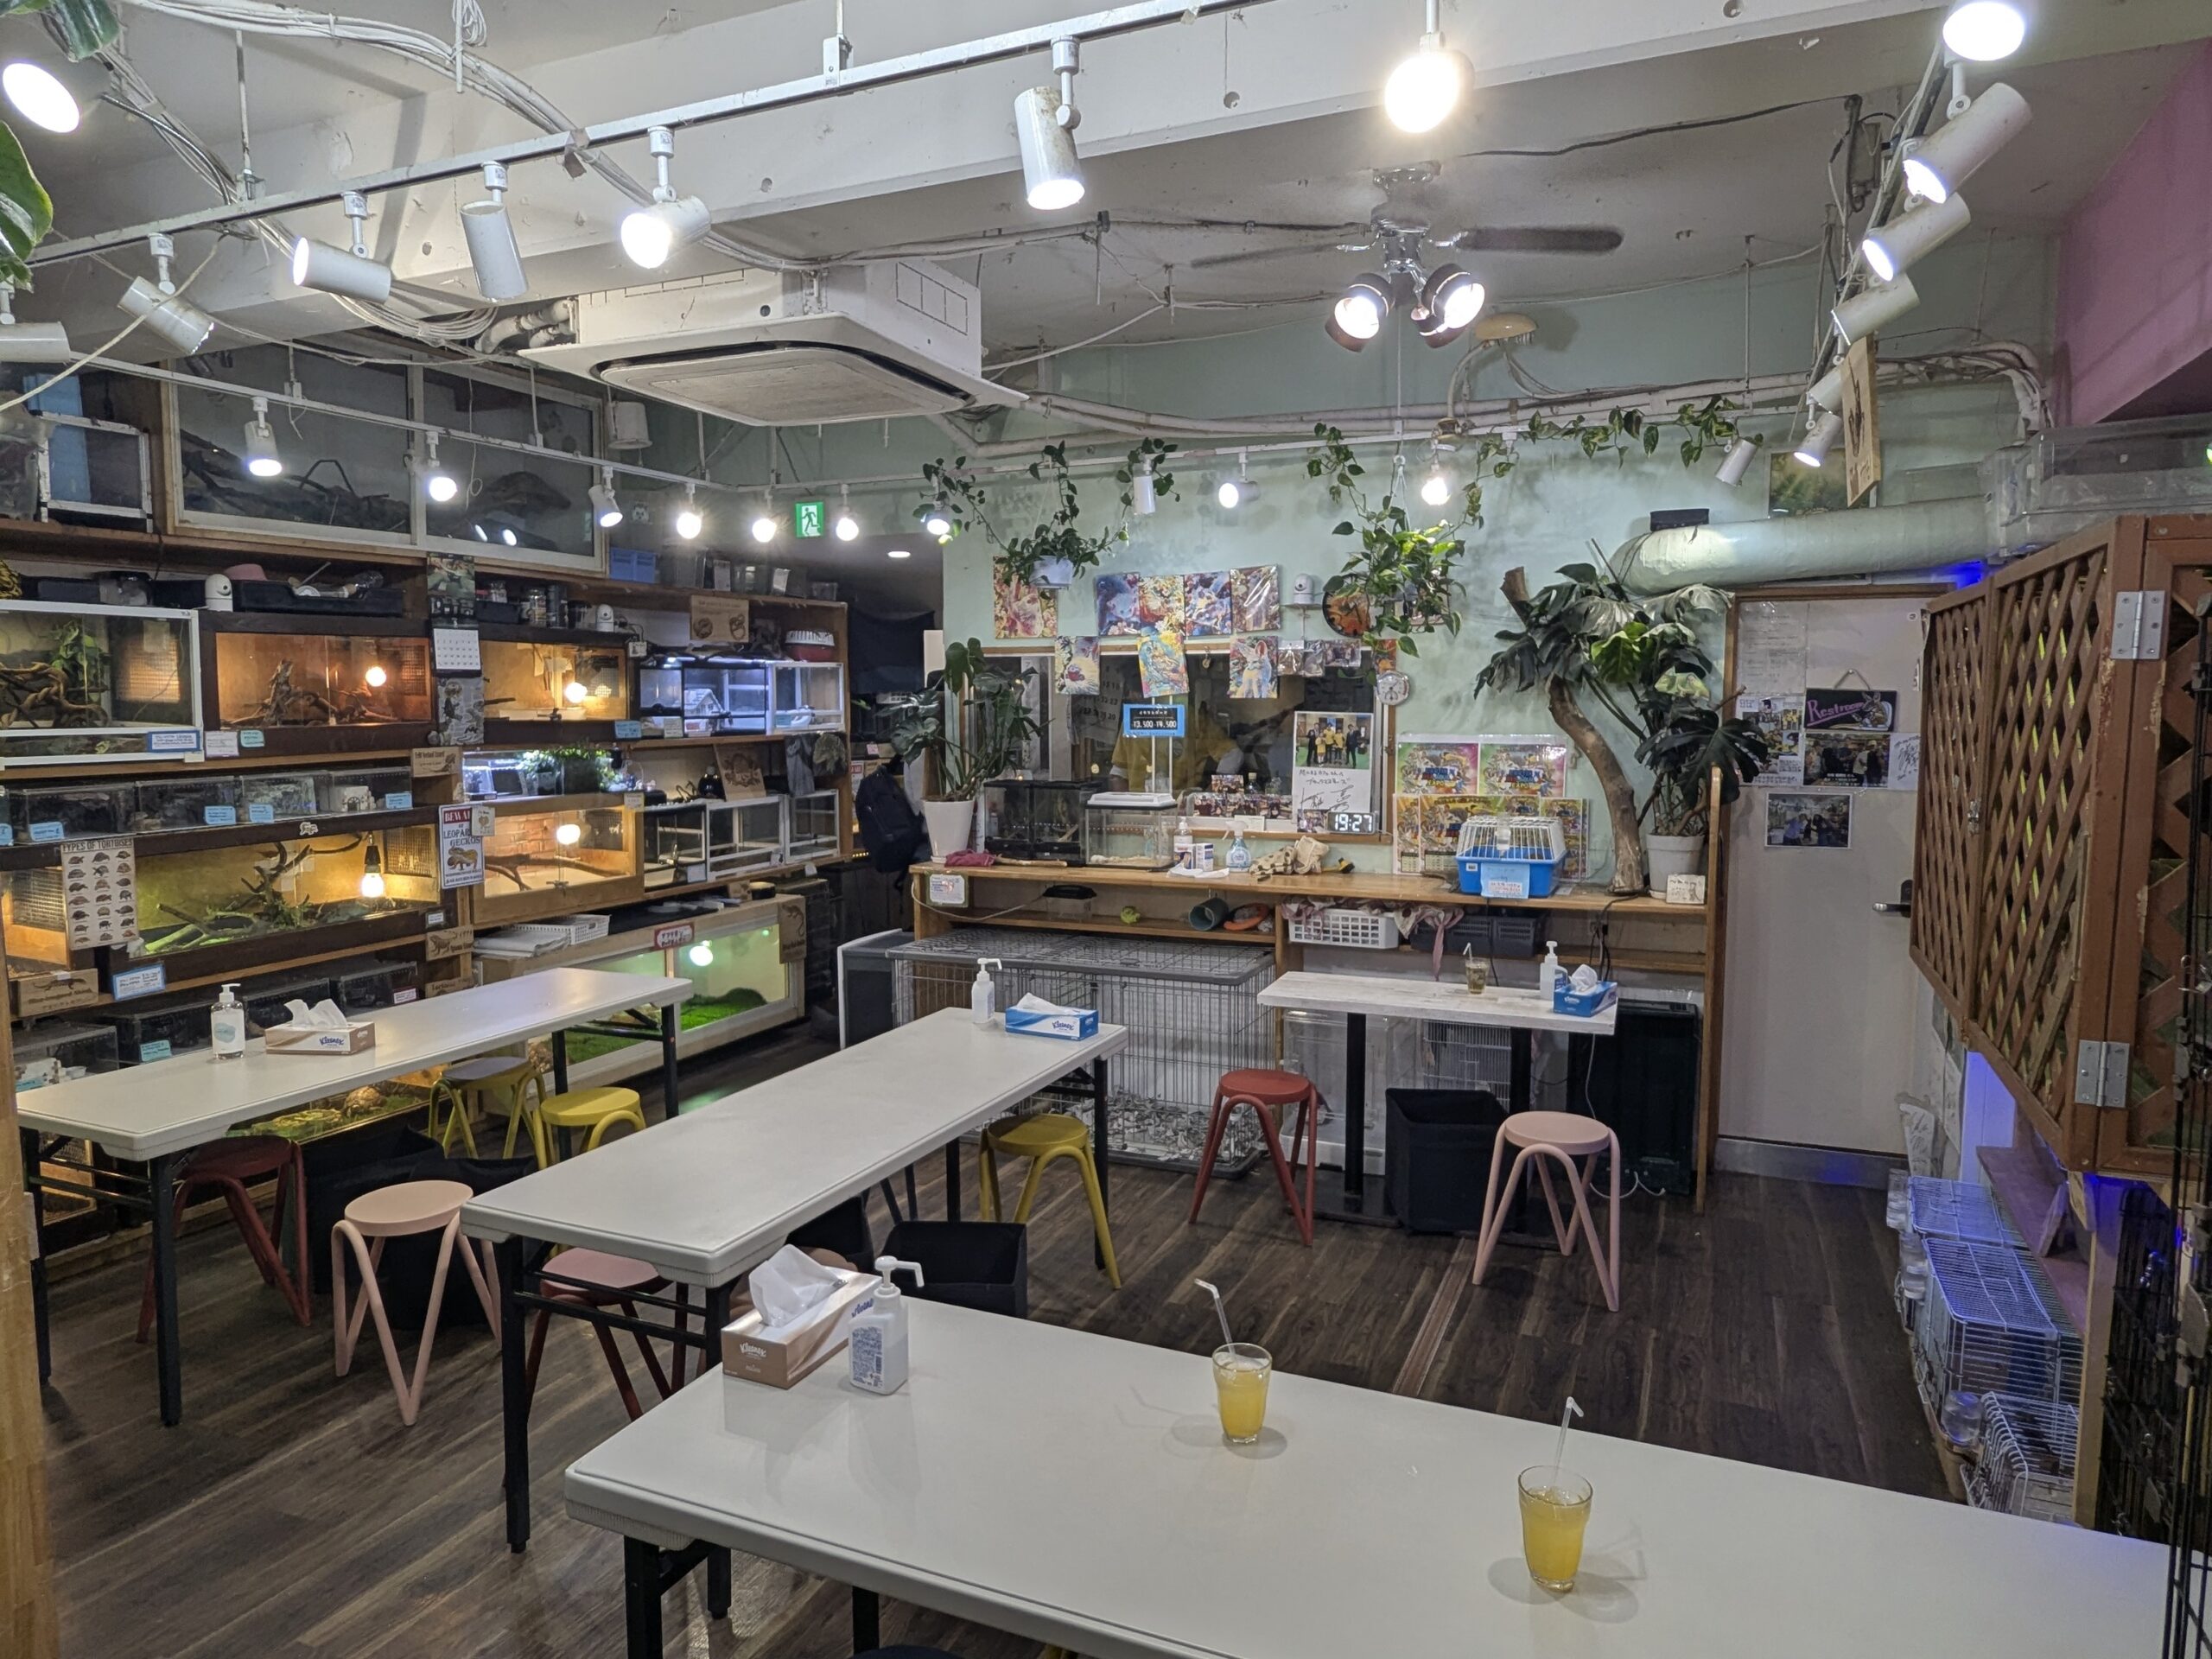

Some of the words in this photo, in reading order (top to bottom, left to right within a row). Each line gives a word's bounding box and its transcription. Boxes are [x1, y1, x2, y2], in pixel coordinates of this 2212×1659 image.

[445, 810, 471, 823] BEWA
[1335, 813, 1372, 831] 19:27
[63, 842, 86, 851] TYPES
[86, 840, 96, 849] OF
[450, 836, 480, 847] GECKOS
[1052, 1020, 1074, 1031] Kleenex
[319, 1035, 344, 1046] Kleenex
